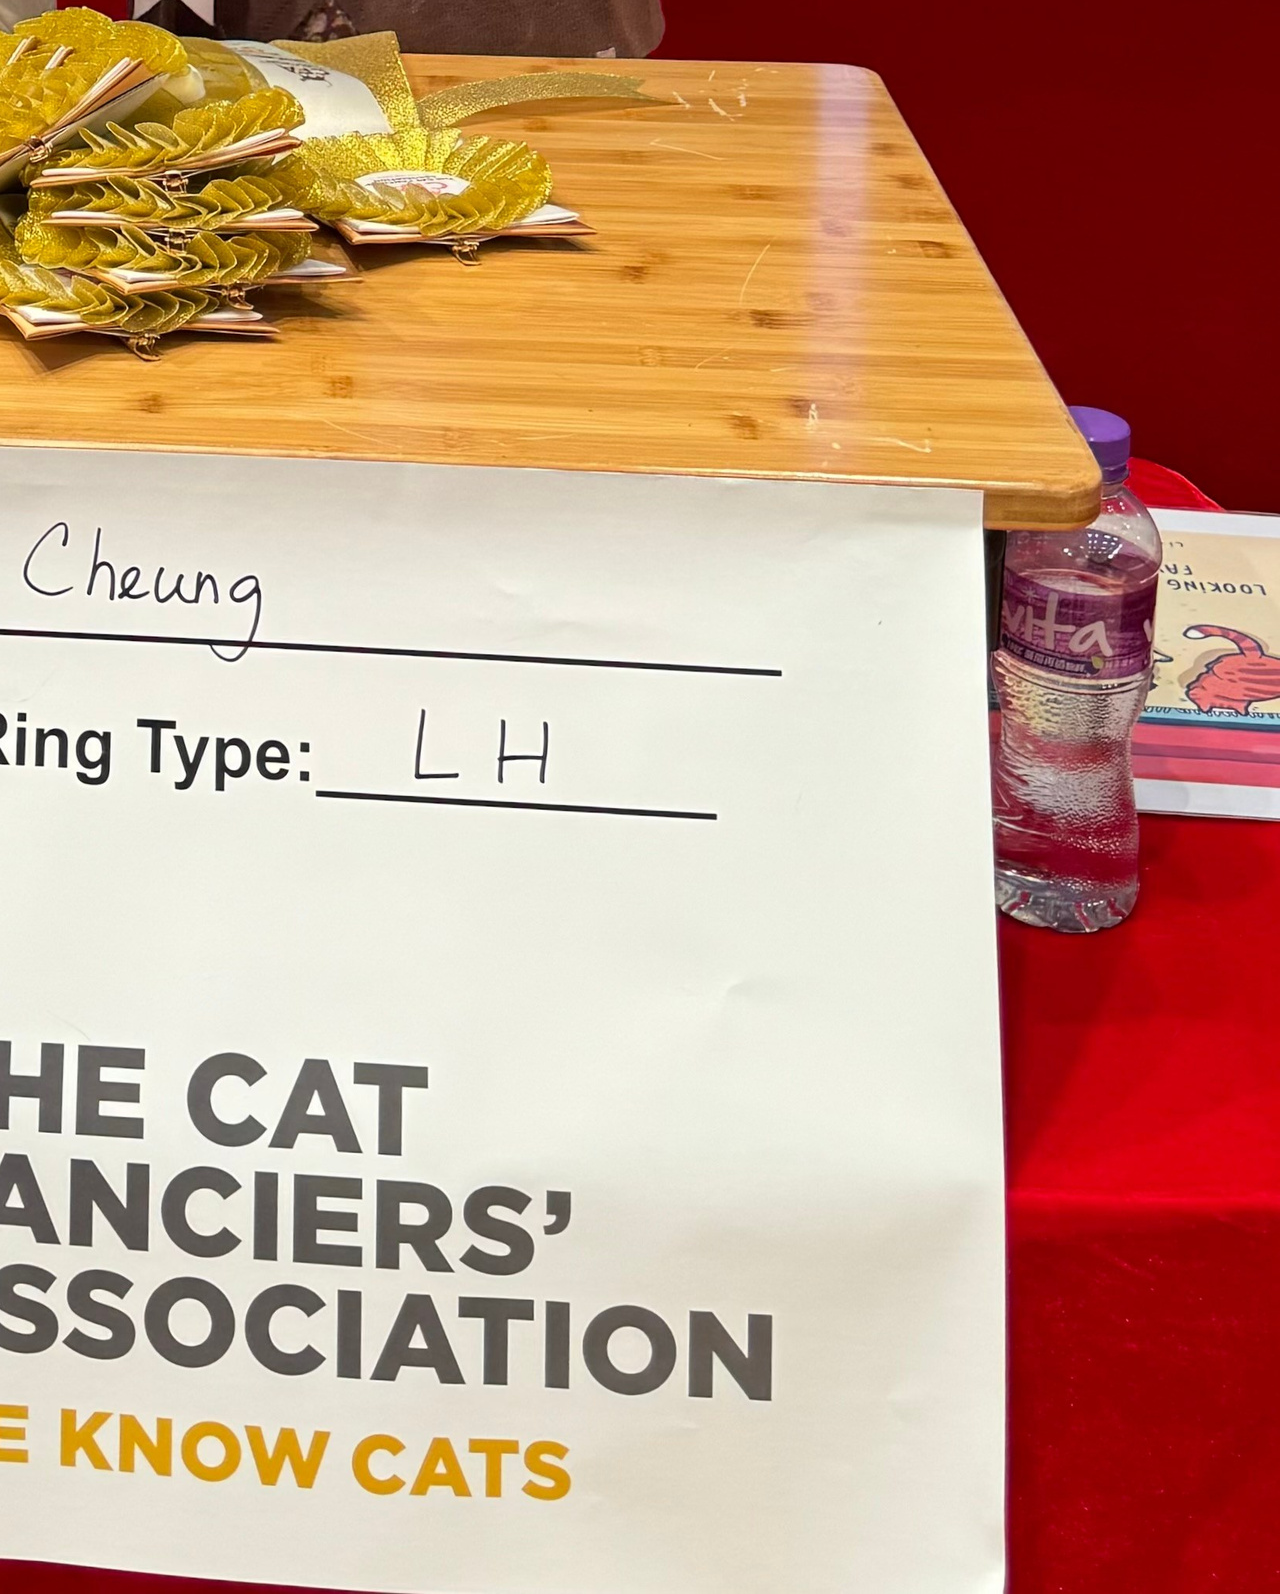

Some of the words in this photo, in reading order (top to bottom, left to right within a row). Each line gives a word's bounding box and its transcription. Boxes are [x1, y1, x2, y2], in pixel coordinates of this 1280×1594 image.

[23, 522, 263, 662] Cheung
[1160, 564, 1193, 576] FA
[1166, 578, 1267, 596] LOOKING
[137, 719, 309, 791] Type:
[188, 1053, 427, 1155] CAT
[61, 1410, 329, 1488] KNOW
[353, 1435, 570, 1500] CATS
